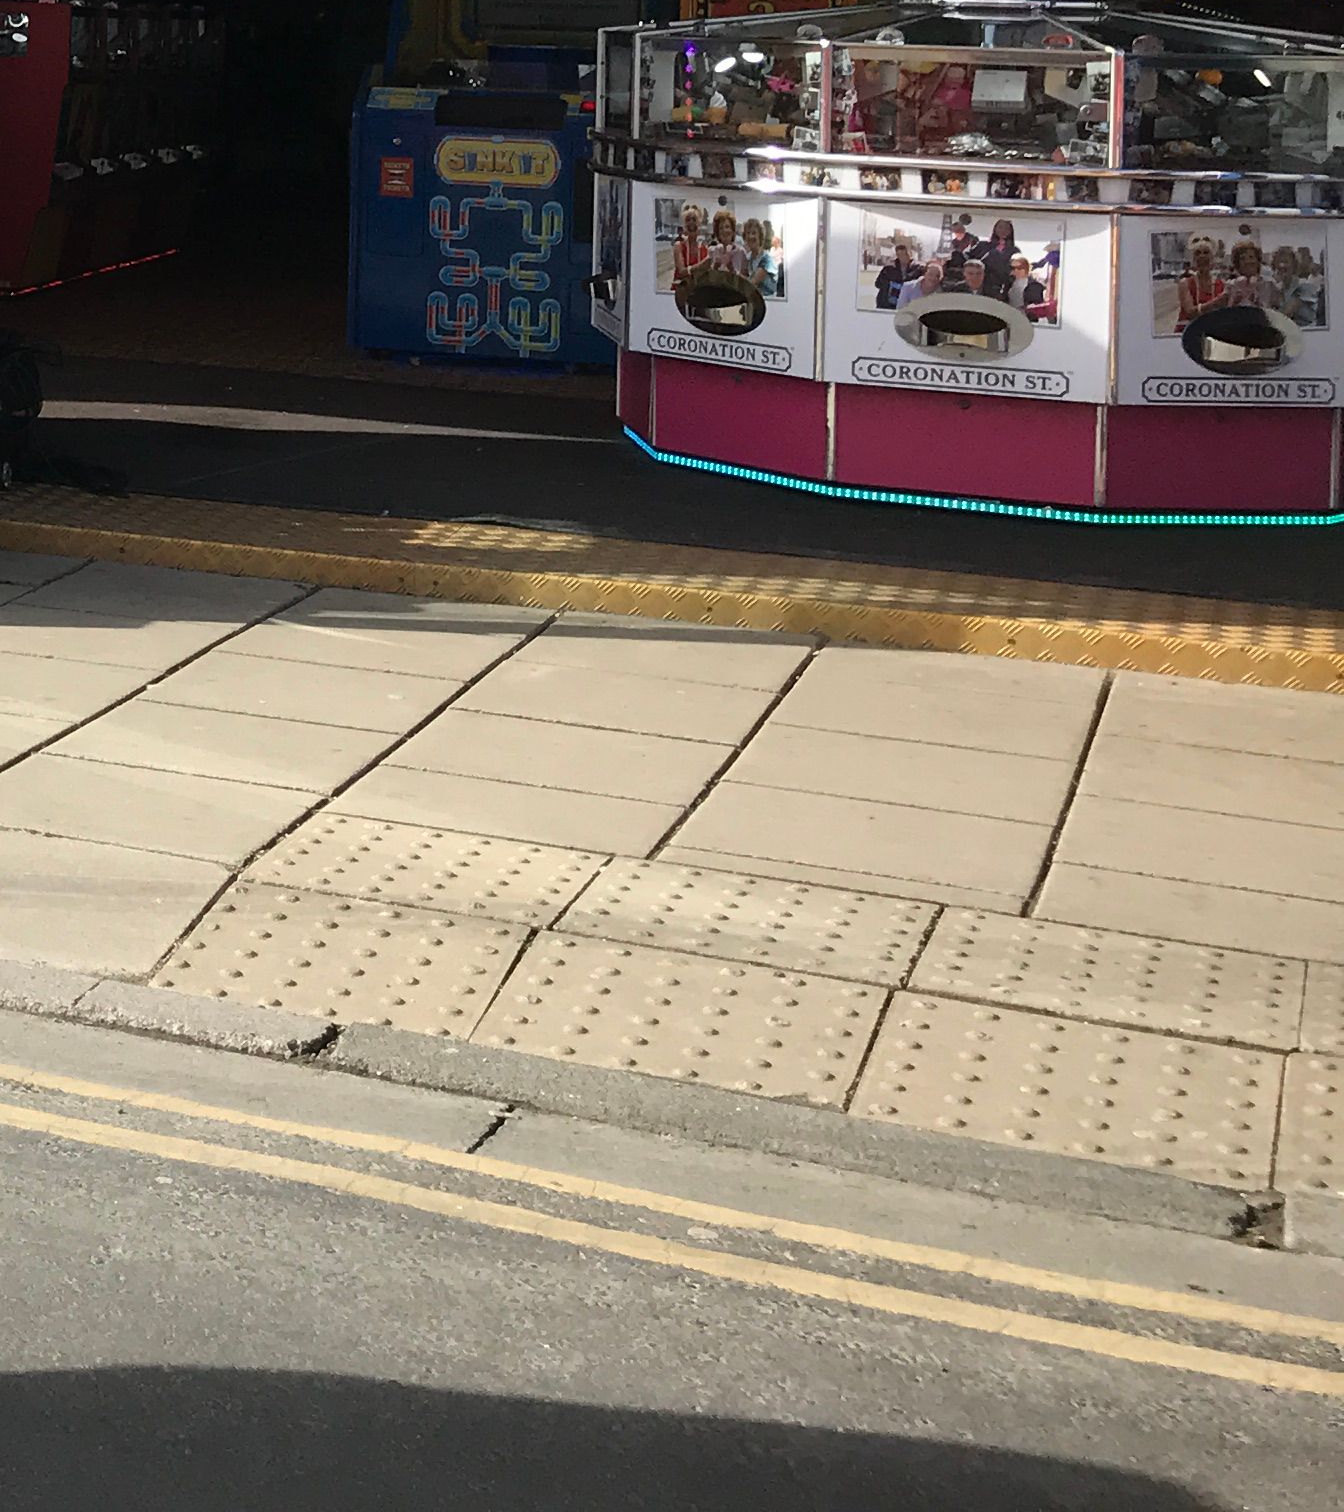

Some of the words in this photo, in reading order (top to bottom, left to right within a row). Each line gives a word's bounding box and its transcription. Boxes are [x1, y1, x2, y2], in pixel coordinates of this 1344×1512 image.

[656, 335, 756, 361] CORONATION
[761, 351, 780, 366] ST.
[867, 363, 1016, 387] CORONATION
[1025, 375, 1052, 391] ST.
[1156, 382, 1289, 398] CORONATION
[1297, 384, 1320, 398] ST.
